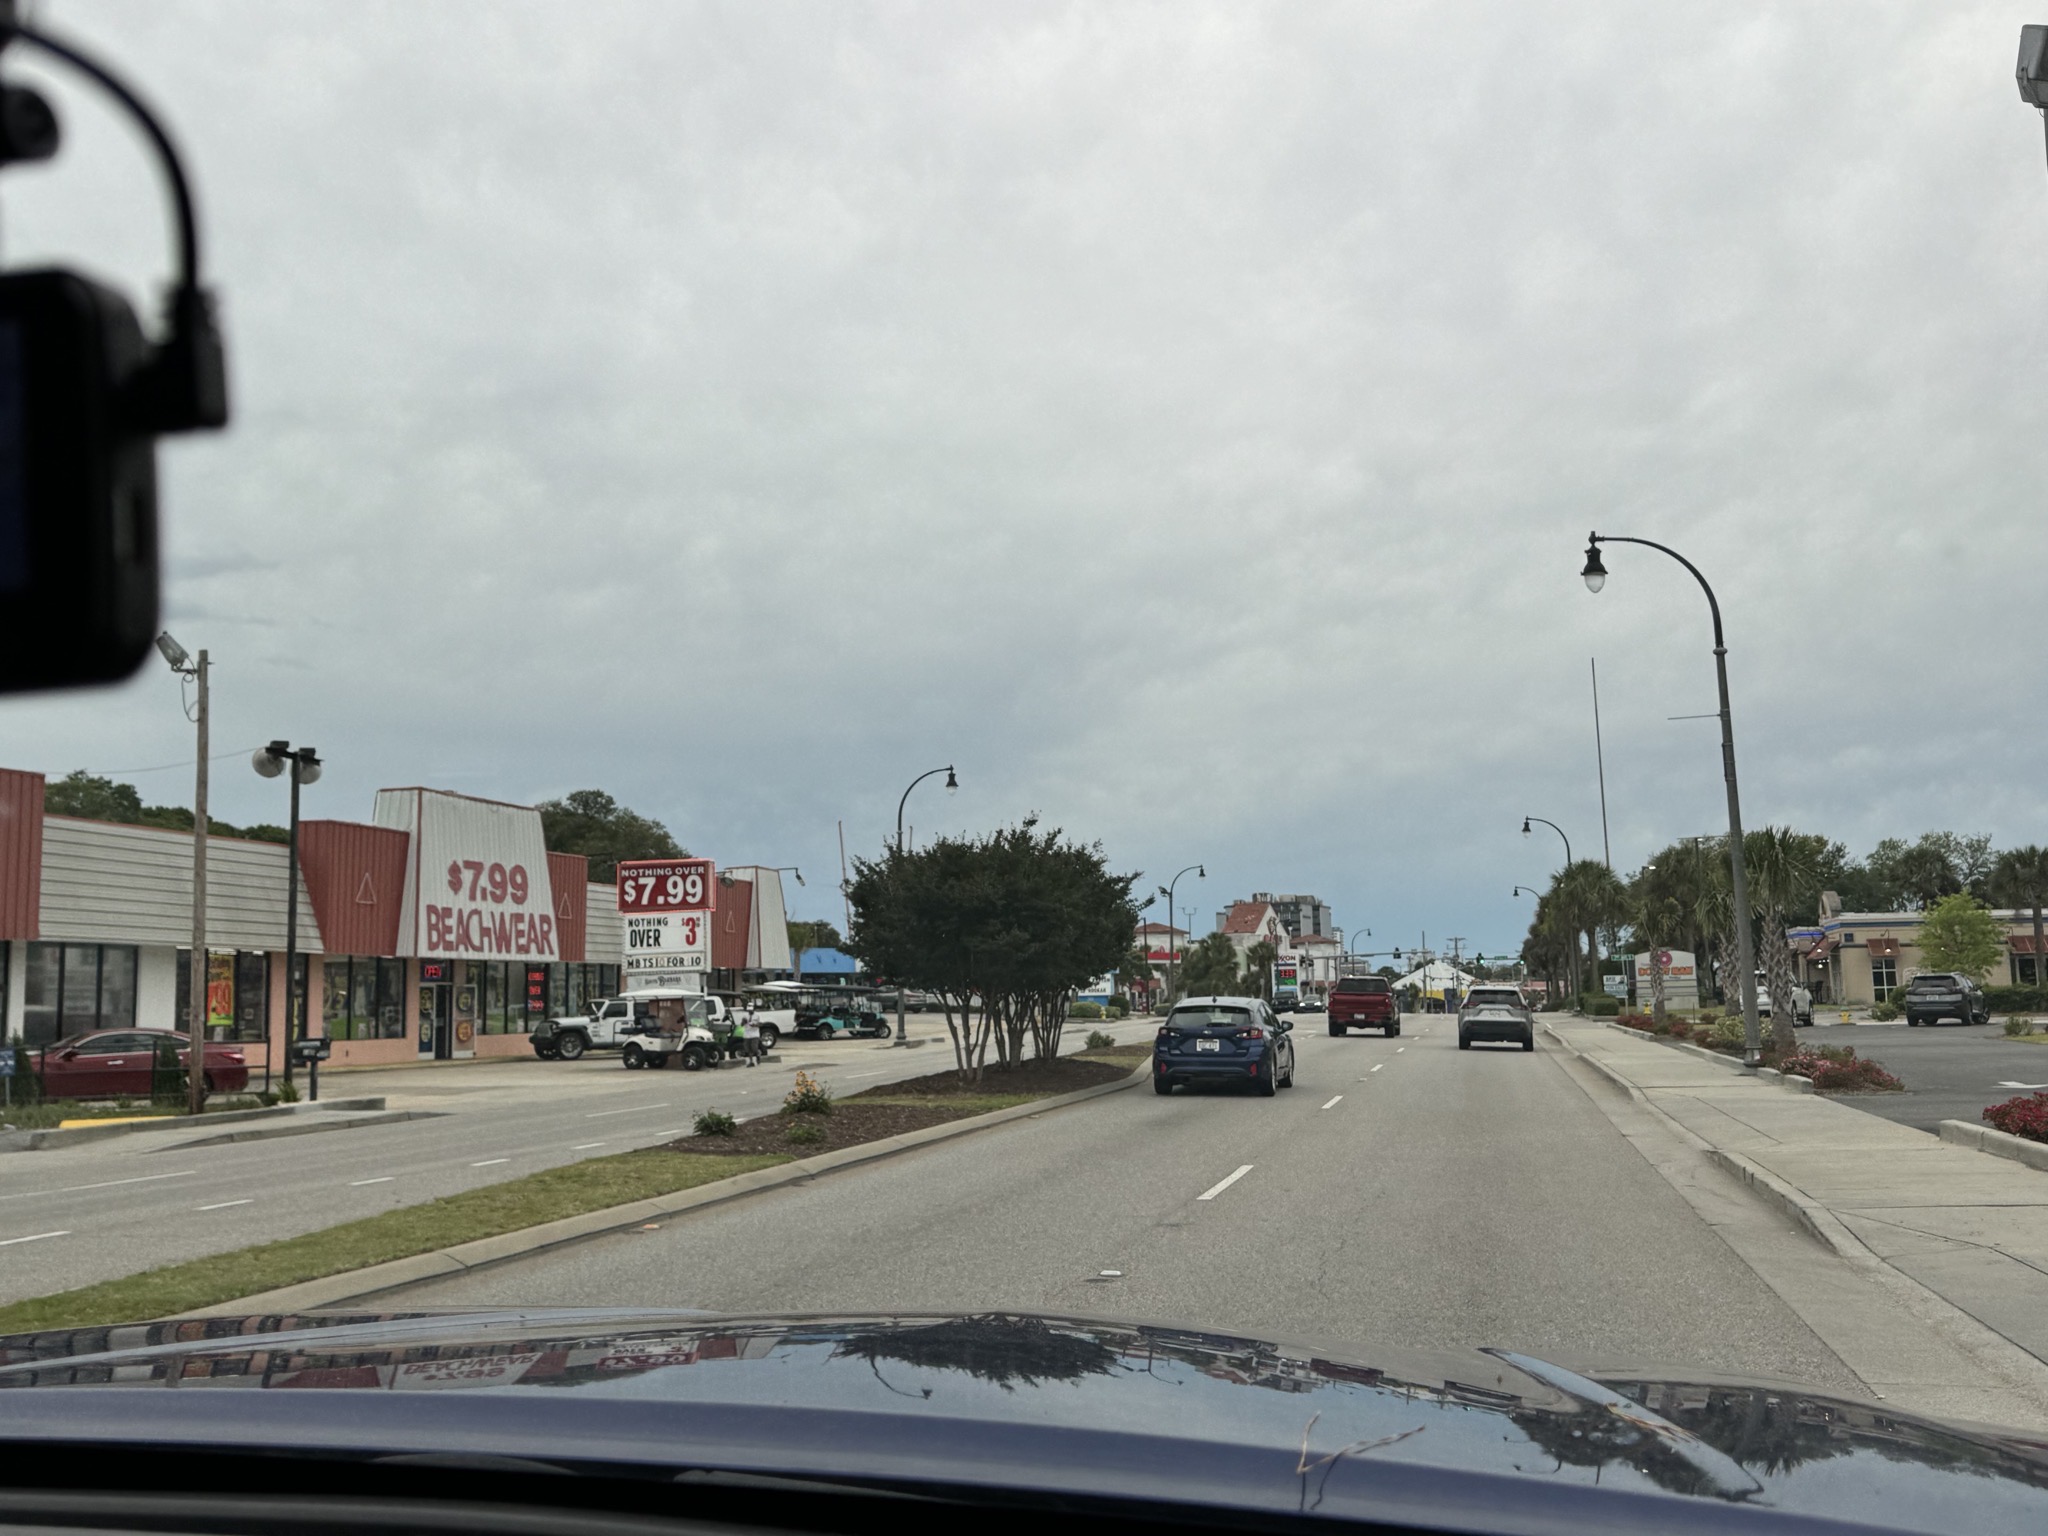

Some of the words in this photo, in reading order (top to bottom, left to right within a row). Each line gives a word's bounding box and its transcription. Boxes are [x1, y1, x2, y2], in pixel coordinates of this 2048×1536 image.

[621, 867, 672, 877] NOTHING
[675, 866, 705, 876] OVER
[447, 860, 529, 905] $7.99
[623, 875, 703, 905] $7.99
[628, 917, 669, 928] NOTHING
[629, 929, 661, 948] OVER
